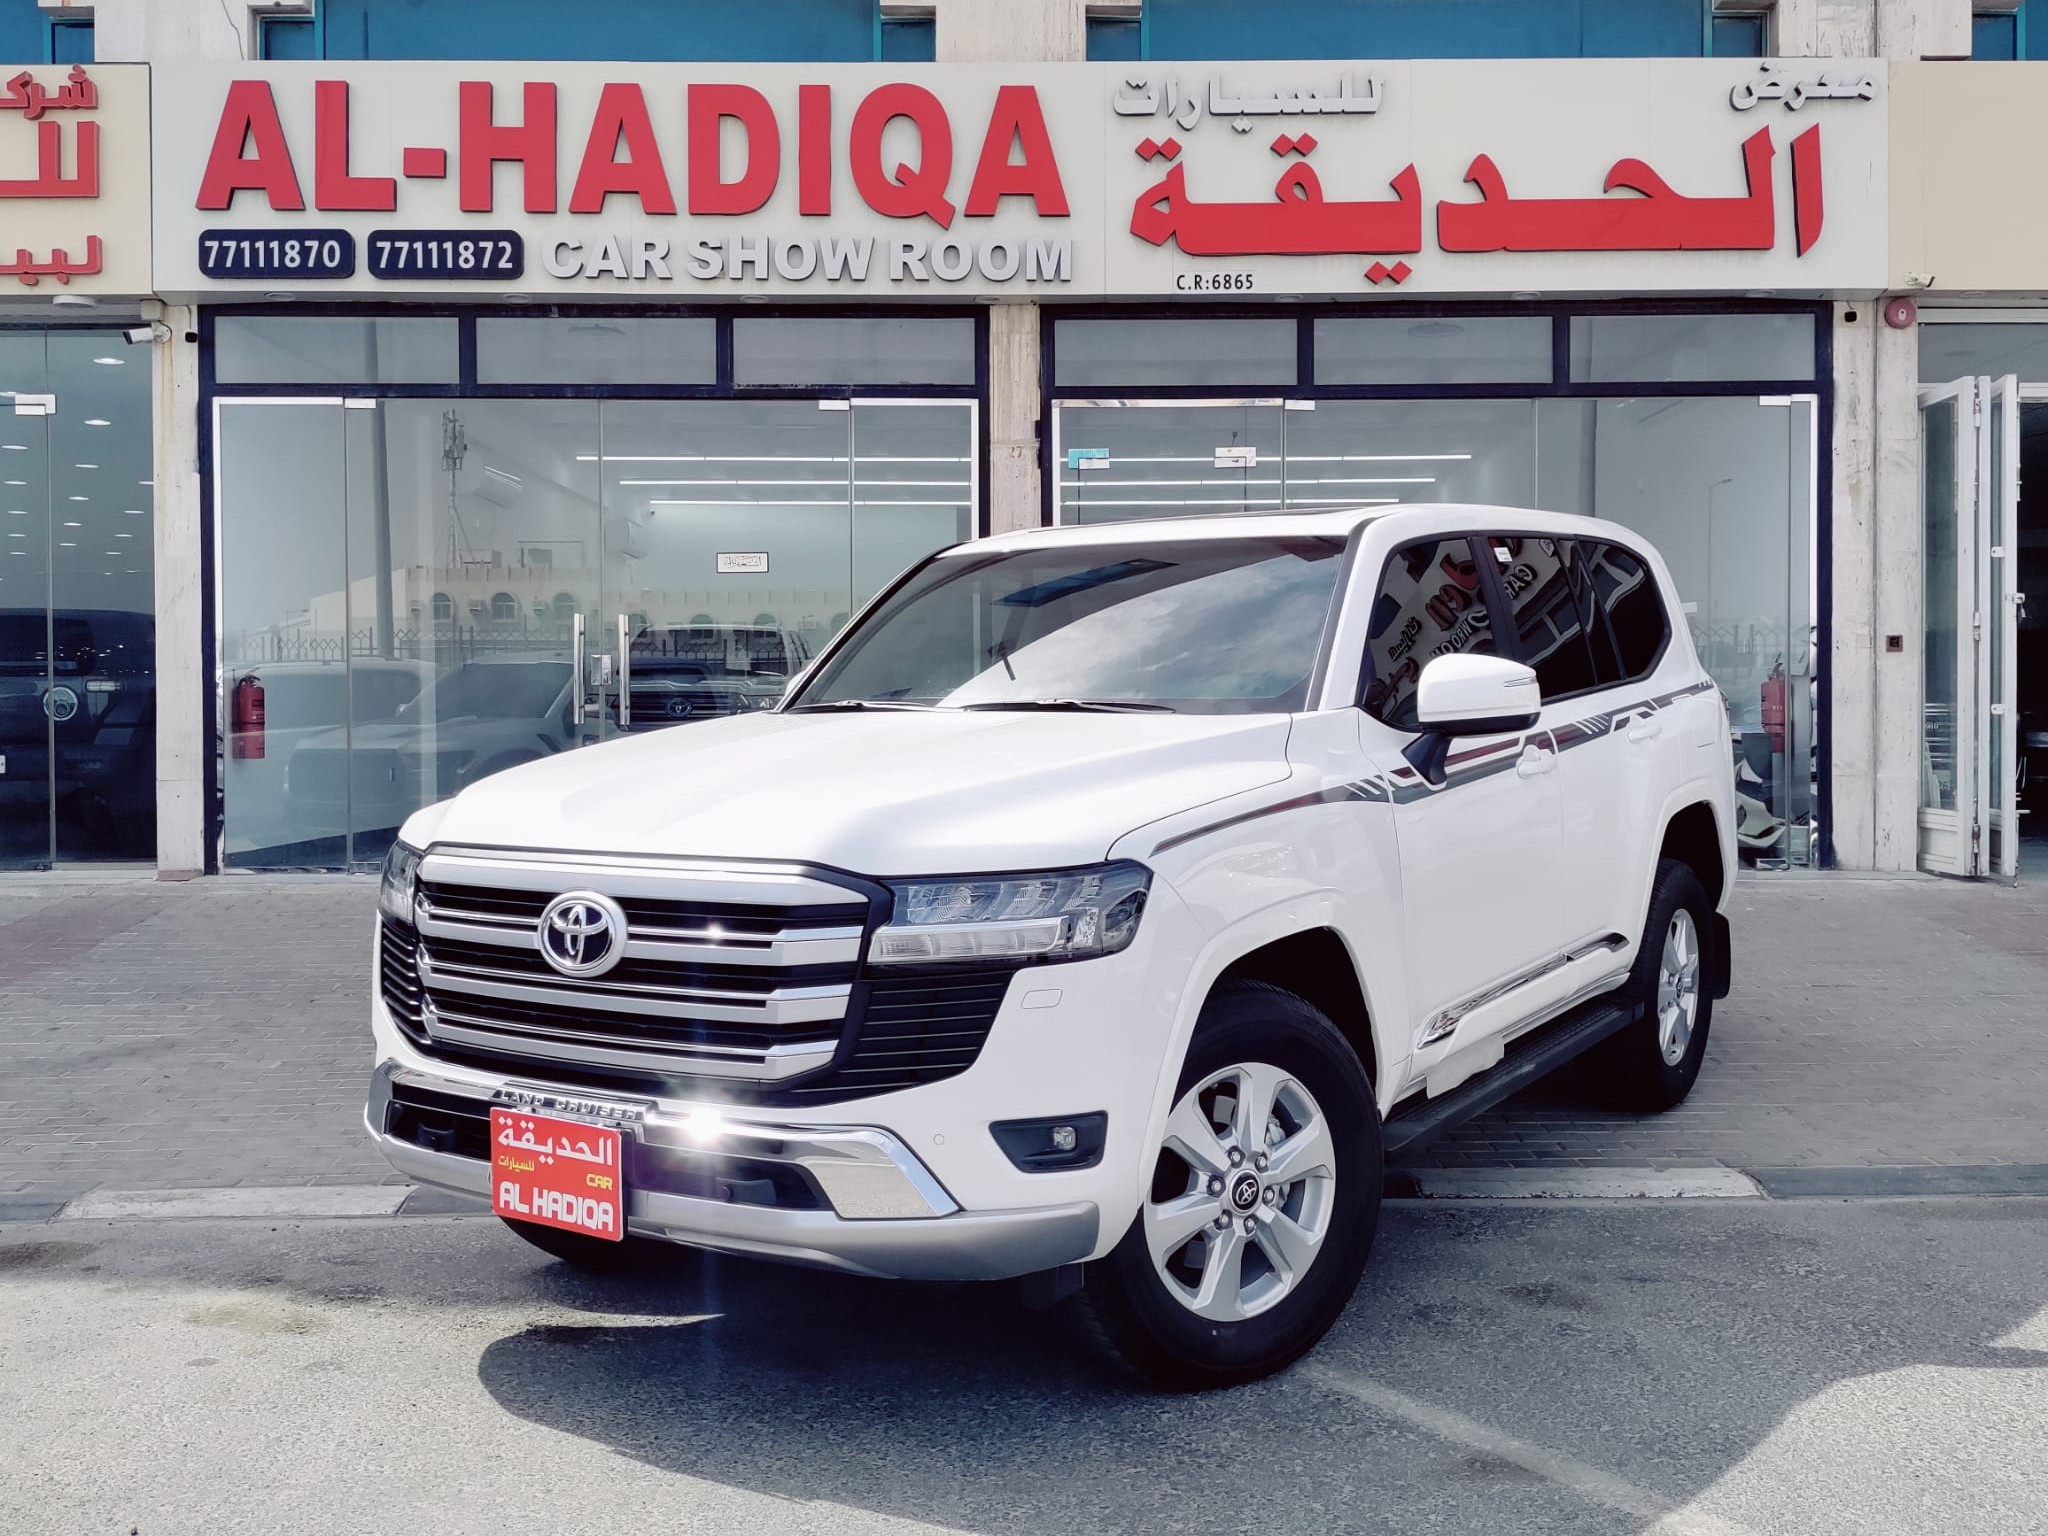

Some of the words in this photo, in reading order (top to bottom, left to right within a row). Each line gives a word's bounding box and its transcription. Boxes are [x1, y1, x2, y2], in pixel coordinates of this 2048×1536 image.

[1113, 72, 1384, 132] للسيارات
[1729, 62, 1876, 112] معرض
[197, 81, 1070, 229] AL-HADIQA
[1131, 124, 1823, 284] الحديقة
[204, 240, 341, 268] 77111870
[376, 241, 513, 269] 77111872
[542, 233, 673, 280] CAR
[686, 234, 874, 281] SHOW
[889, 236, 1073, 282] ROOM
[1176, 274, 1254, 290] C.R:6865
[498, 1116, 613, 1166] الحديقة
[498, 1155, 535, 1173] للسيارات
[500, 1181, 530, 1214] AL
[532, 1187, 613, 1232] HADIQA
[586, 1173, 613, 1190] CAR
